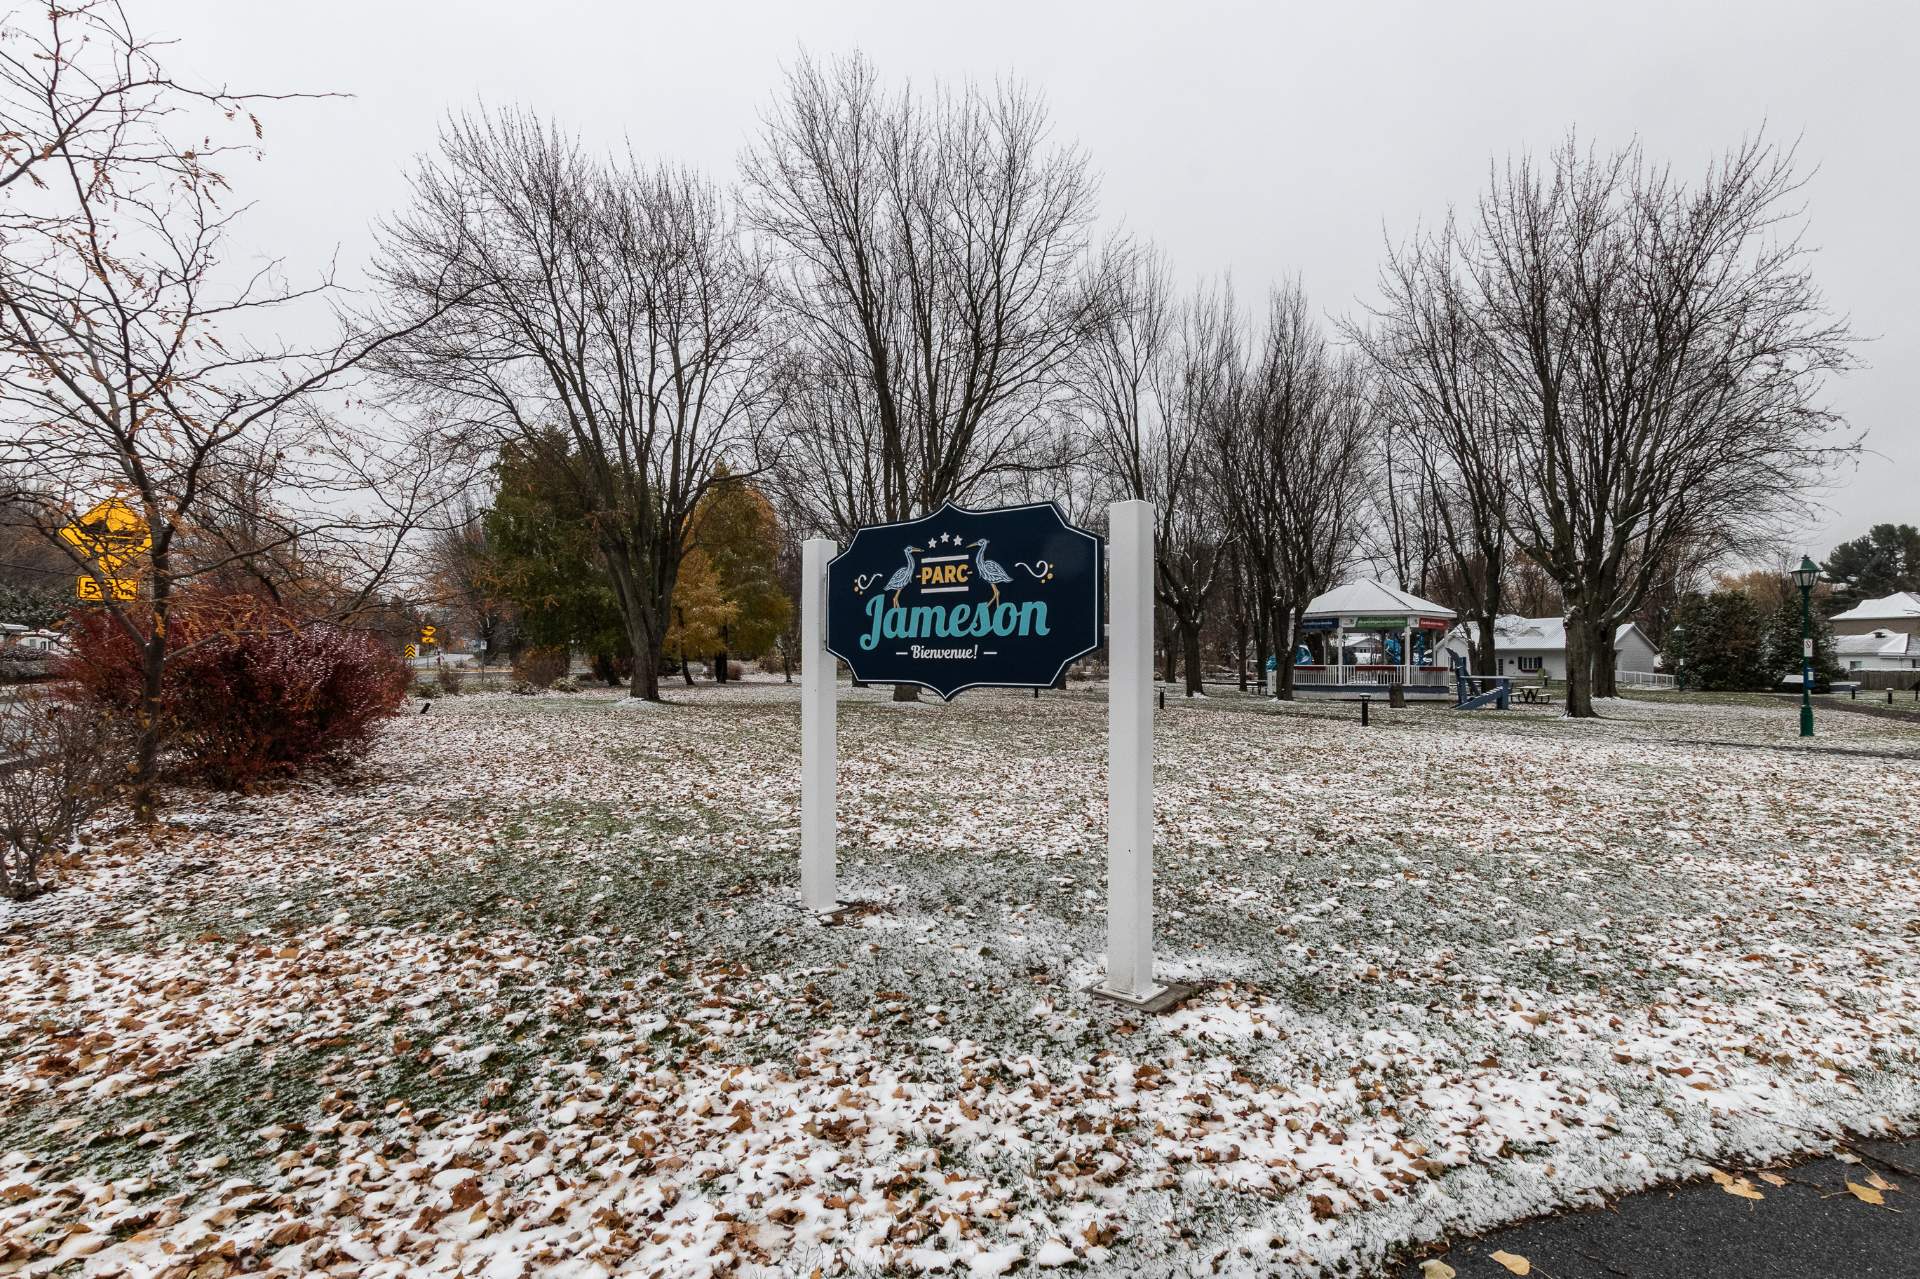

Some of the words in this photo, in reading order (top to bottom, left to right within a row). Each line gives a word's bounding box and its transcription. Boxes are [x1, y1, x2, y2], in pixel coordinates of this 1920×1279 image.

[921, 564, 969, 585] PARC
[859, 594, 1051, 651] Jameson
[910, 644, 979, 660] Bienvenue!
